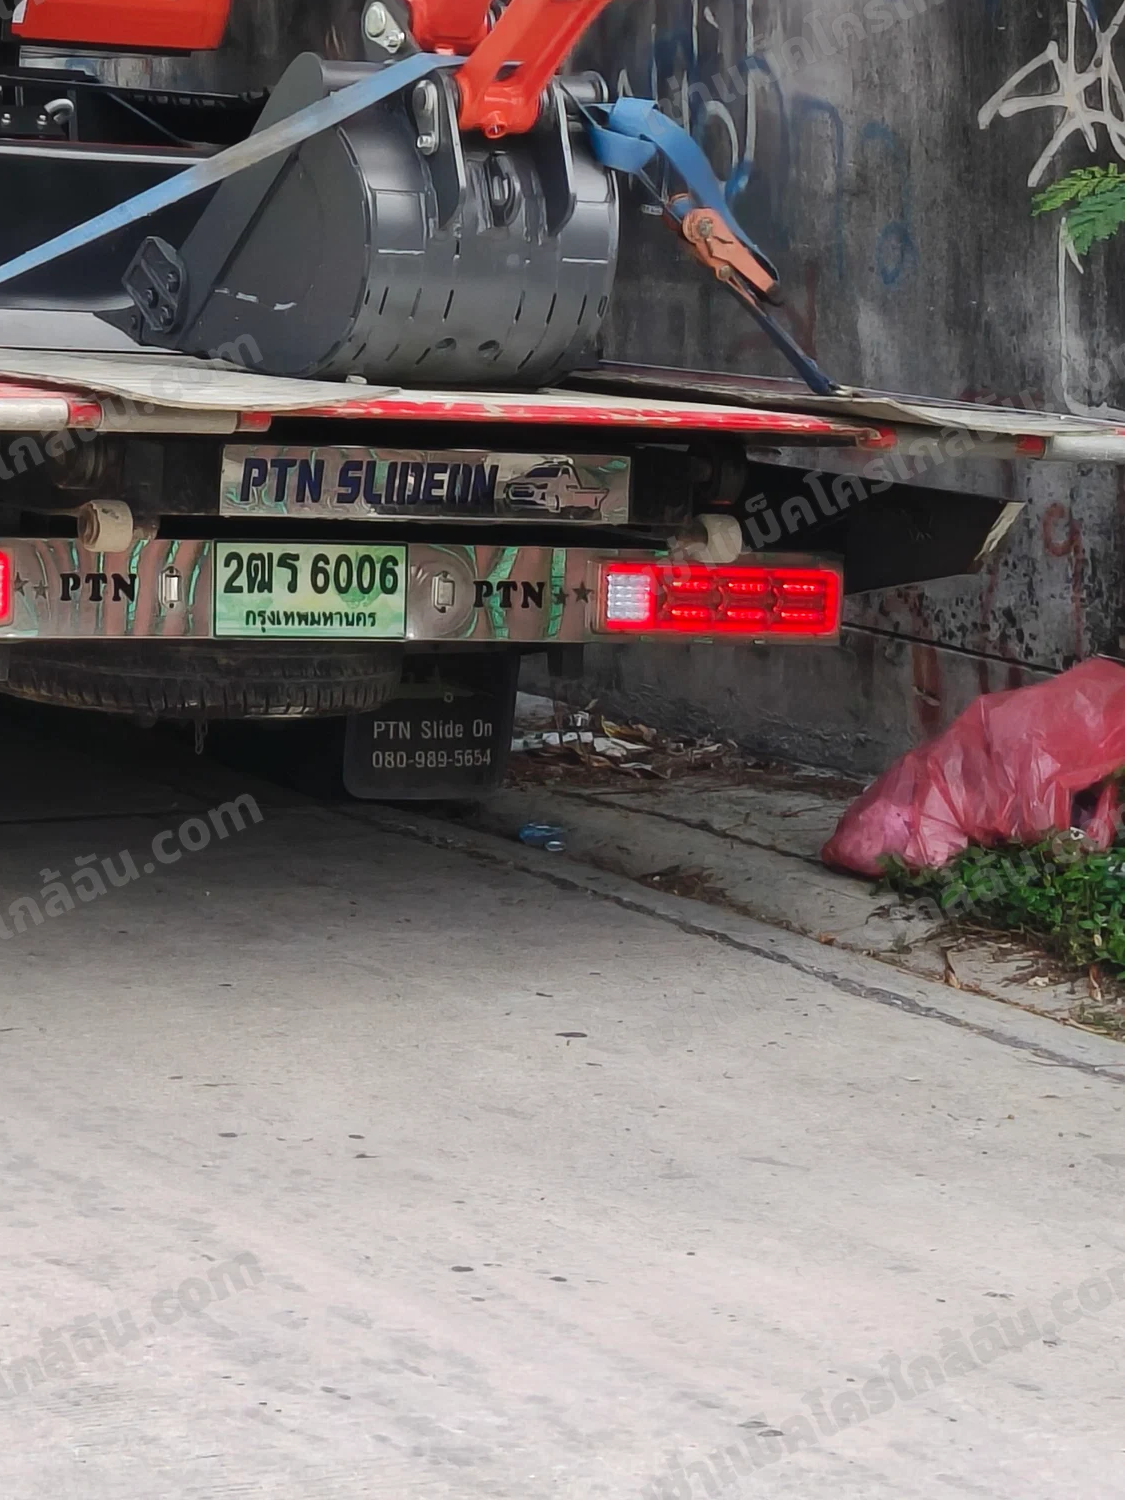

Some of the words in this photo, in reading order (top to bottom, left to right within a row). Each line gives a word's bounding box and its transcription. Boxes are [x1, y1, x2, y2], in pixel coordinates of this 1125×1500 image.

[239, 457, 323, 504] PTN
[336, 458, 501, 507] SLIDEON
[60, 572, 140, 603] PTN
[310, 553, 399, 595] 6006
[473, 578, 546, 610] PTN
[373, 720, 411, 740] PTN
[421, 720, 464, 740] Slide
[472, 718, 493, 738] On
[371, 748, 492, 769] 080-989-5654
